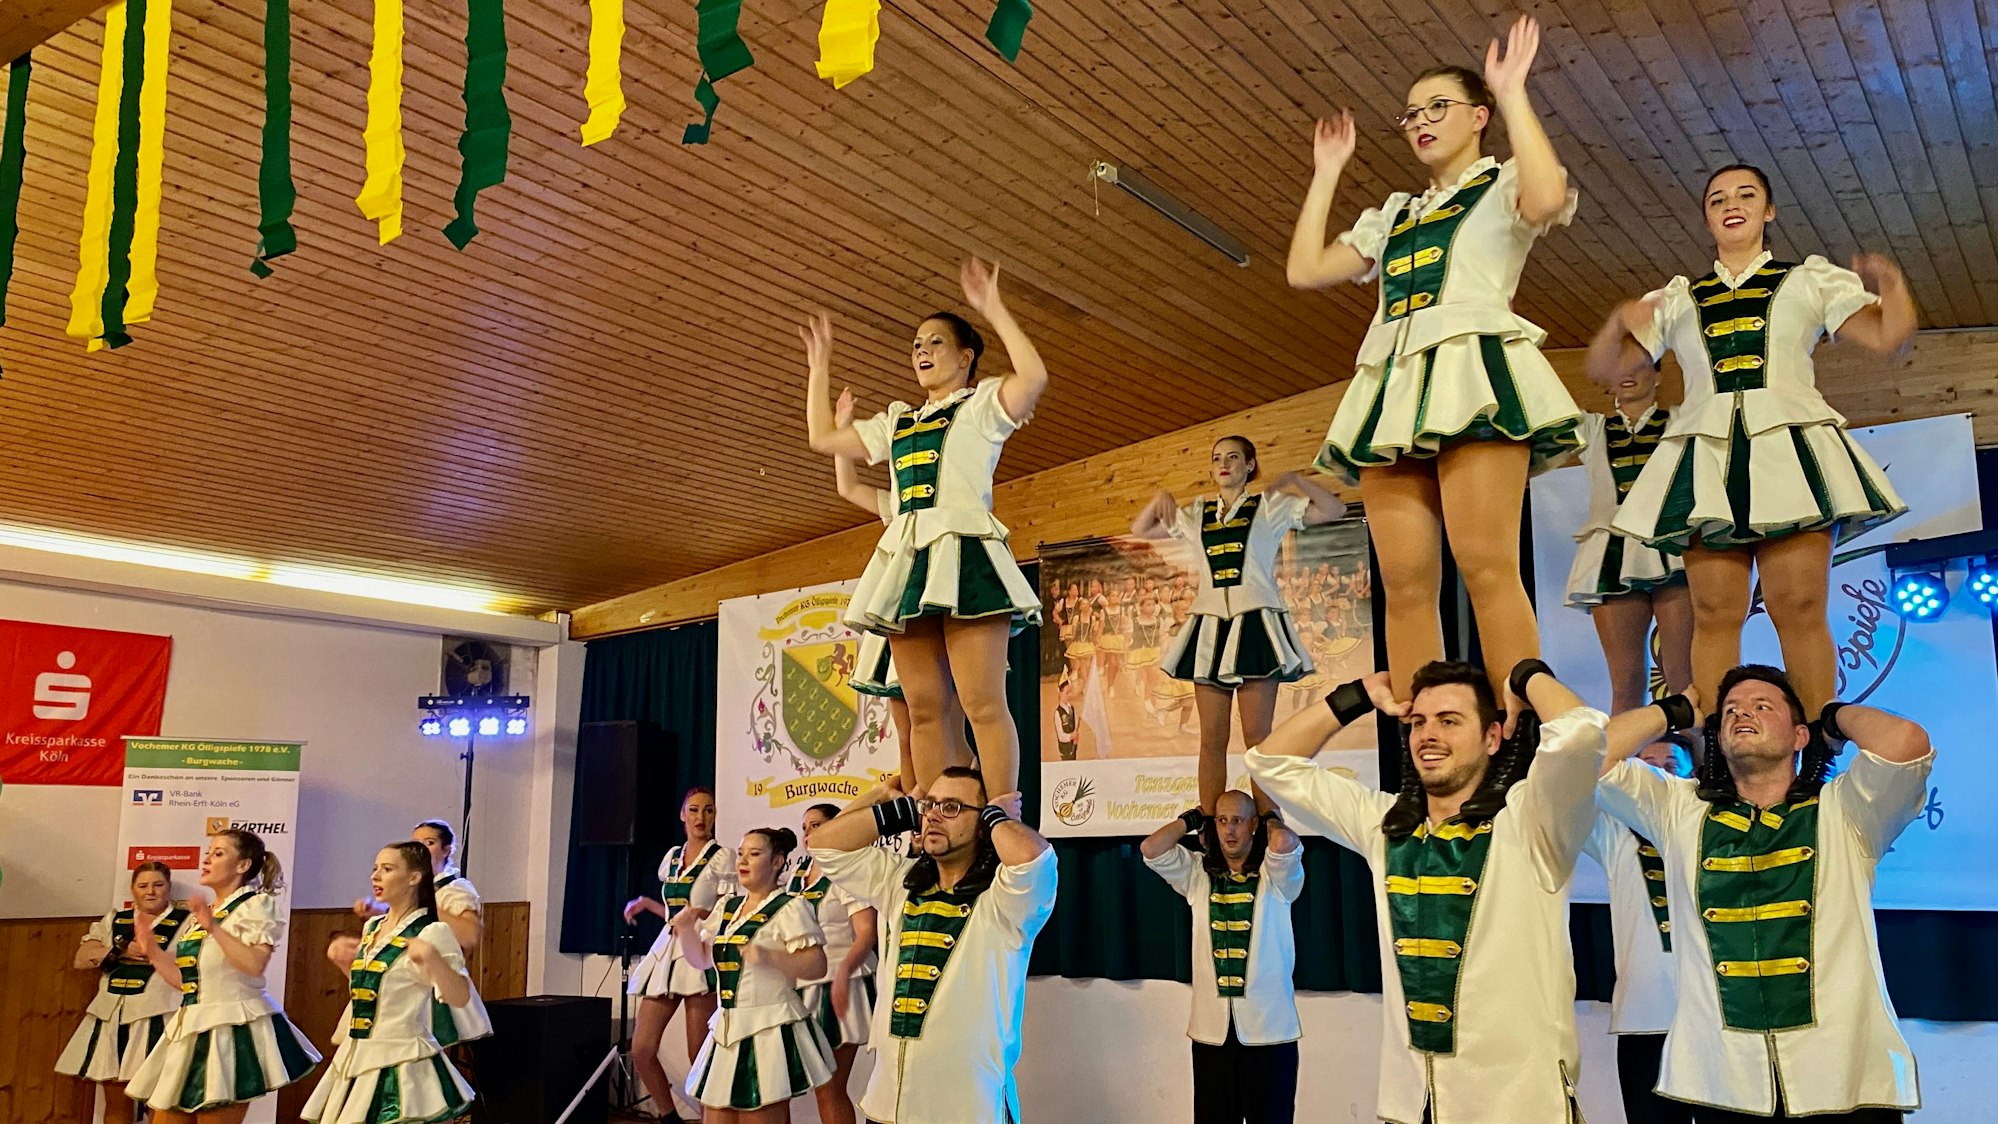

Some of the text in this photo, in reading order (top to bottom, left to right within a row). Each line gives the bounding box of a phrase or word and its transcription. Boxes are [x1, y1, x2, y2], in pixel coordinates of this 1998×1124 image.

[5, 732, 107, 748] Kreissparkasse
[131, 741, 180, 750] Vochemer
[181, 743, 196, 751] KG
[272, 746, 290, 754] e.V.
[39, 750, 69, 762] Köln
[186, 757, 239, 767] Burgwache
[169, 790, 202, 798] VR-Bank
[754, 783, 763, 796] 19
[785, 780, 859, 800] Burgwache
[1106, 799, 1179, 819] Vochemer
[230, 822, 288, 834] BARTHEL
